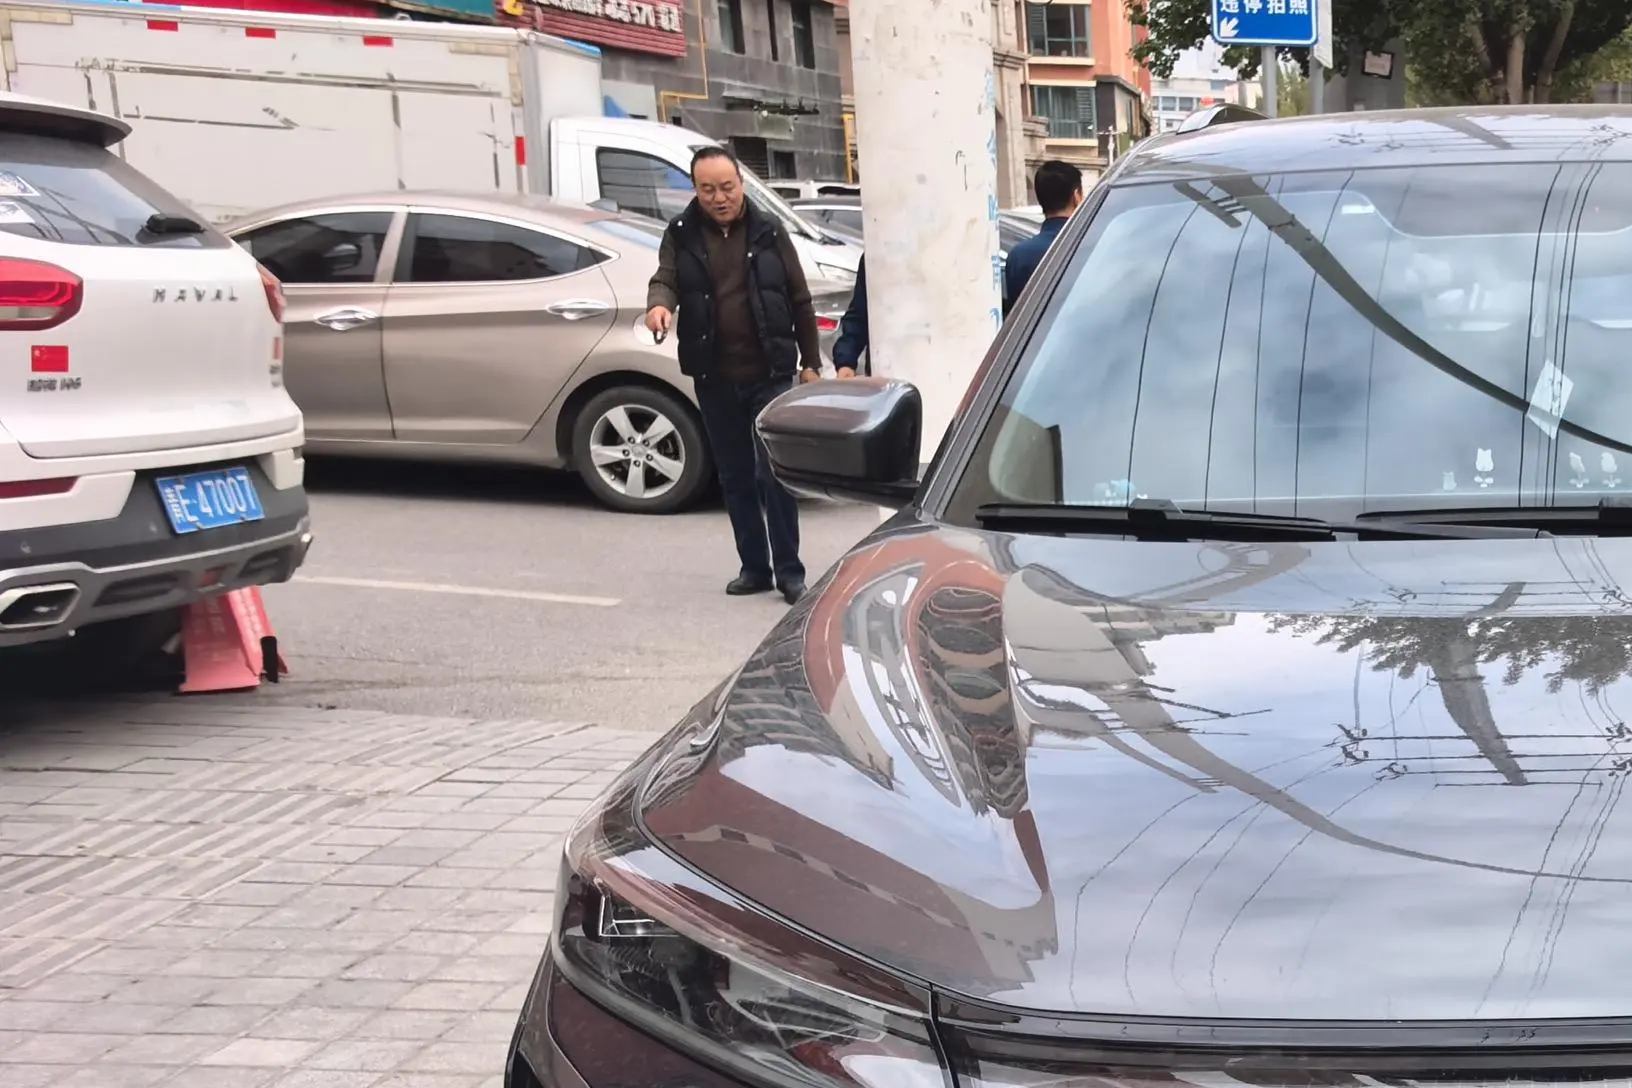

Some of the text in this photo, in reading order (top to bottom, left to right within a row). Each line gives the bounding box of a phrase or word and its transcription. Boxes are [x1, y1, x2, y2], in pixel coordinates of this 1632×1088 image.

[1220, 0, 1308, 15] 违停拍照
[152, 286, 239, 303] HAVAL
